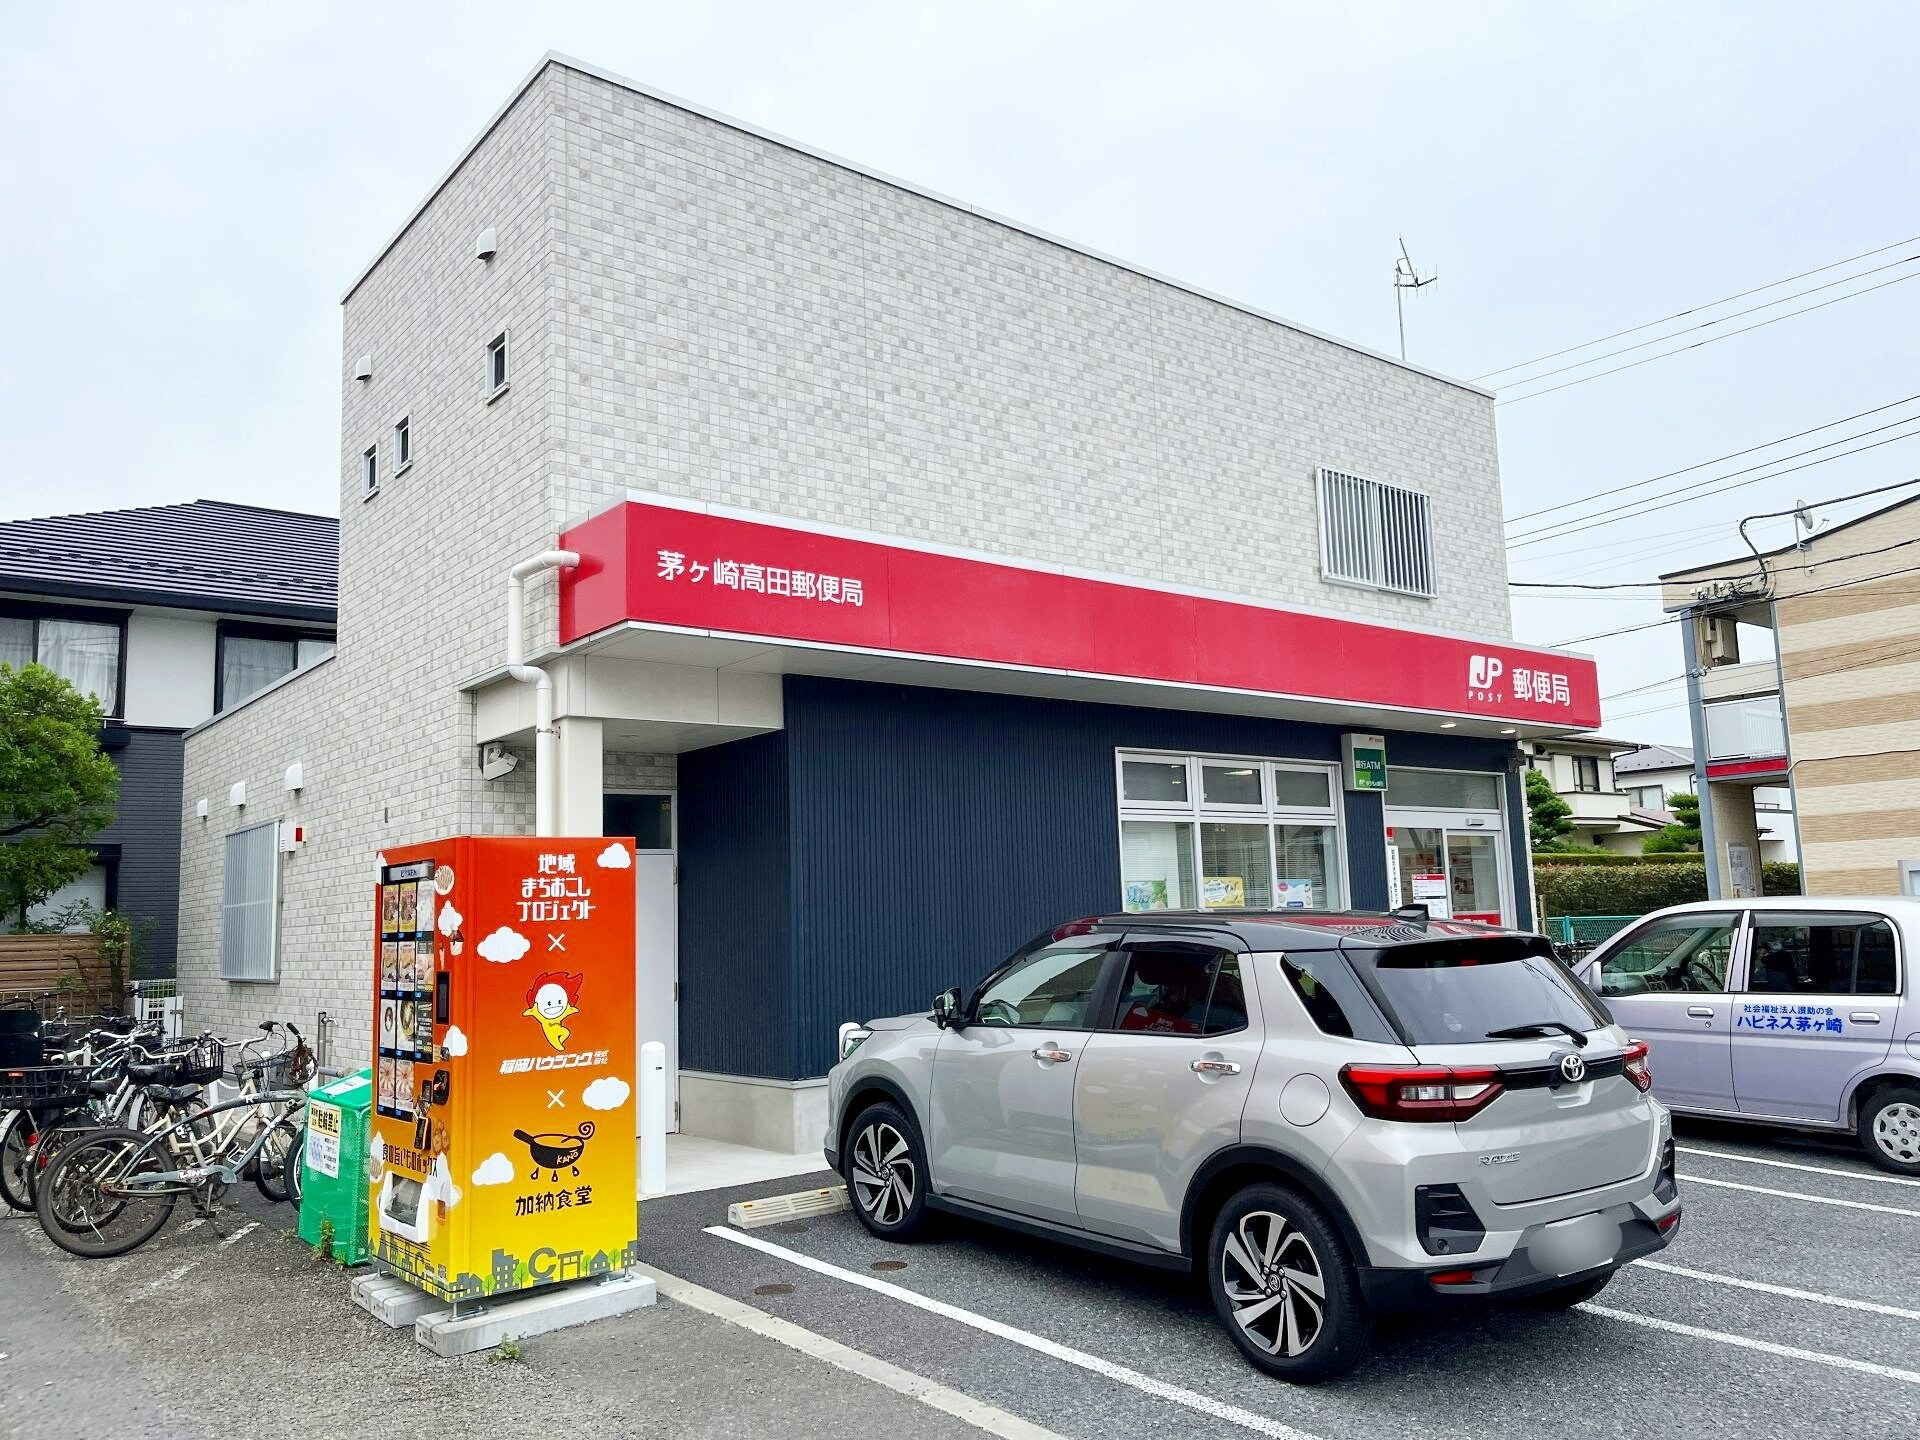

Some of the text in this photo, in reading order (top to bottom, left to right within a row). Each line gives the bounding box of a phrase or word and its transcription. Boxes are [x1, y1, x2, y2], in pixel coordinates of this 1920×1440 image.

[657, 550, 863, 606] 茅ヶ崎高田郵便局
[1468, 655, 1503, 689] JP
[1468, 690, 1502, 703] POST
[1512, 668, 1571, 706] 郵便局
[538, 853, 576, 875] 地域
[522, 877, 591, 898] まちおこし
[516, 900, 596, 922] プロジェクト
[1737, 1015, 1842, 1033] ハピネス茅ヶ崎
[516, 1185, 592, 1216] 加納食堂
